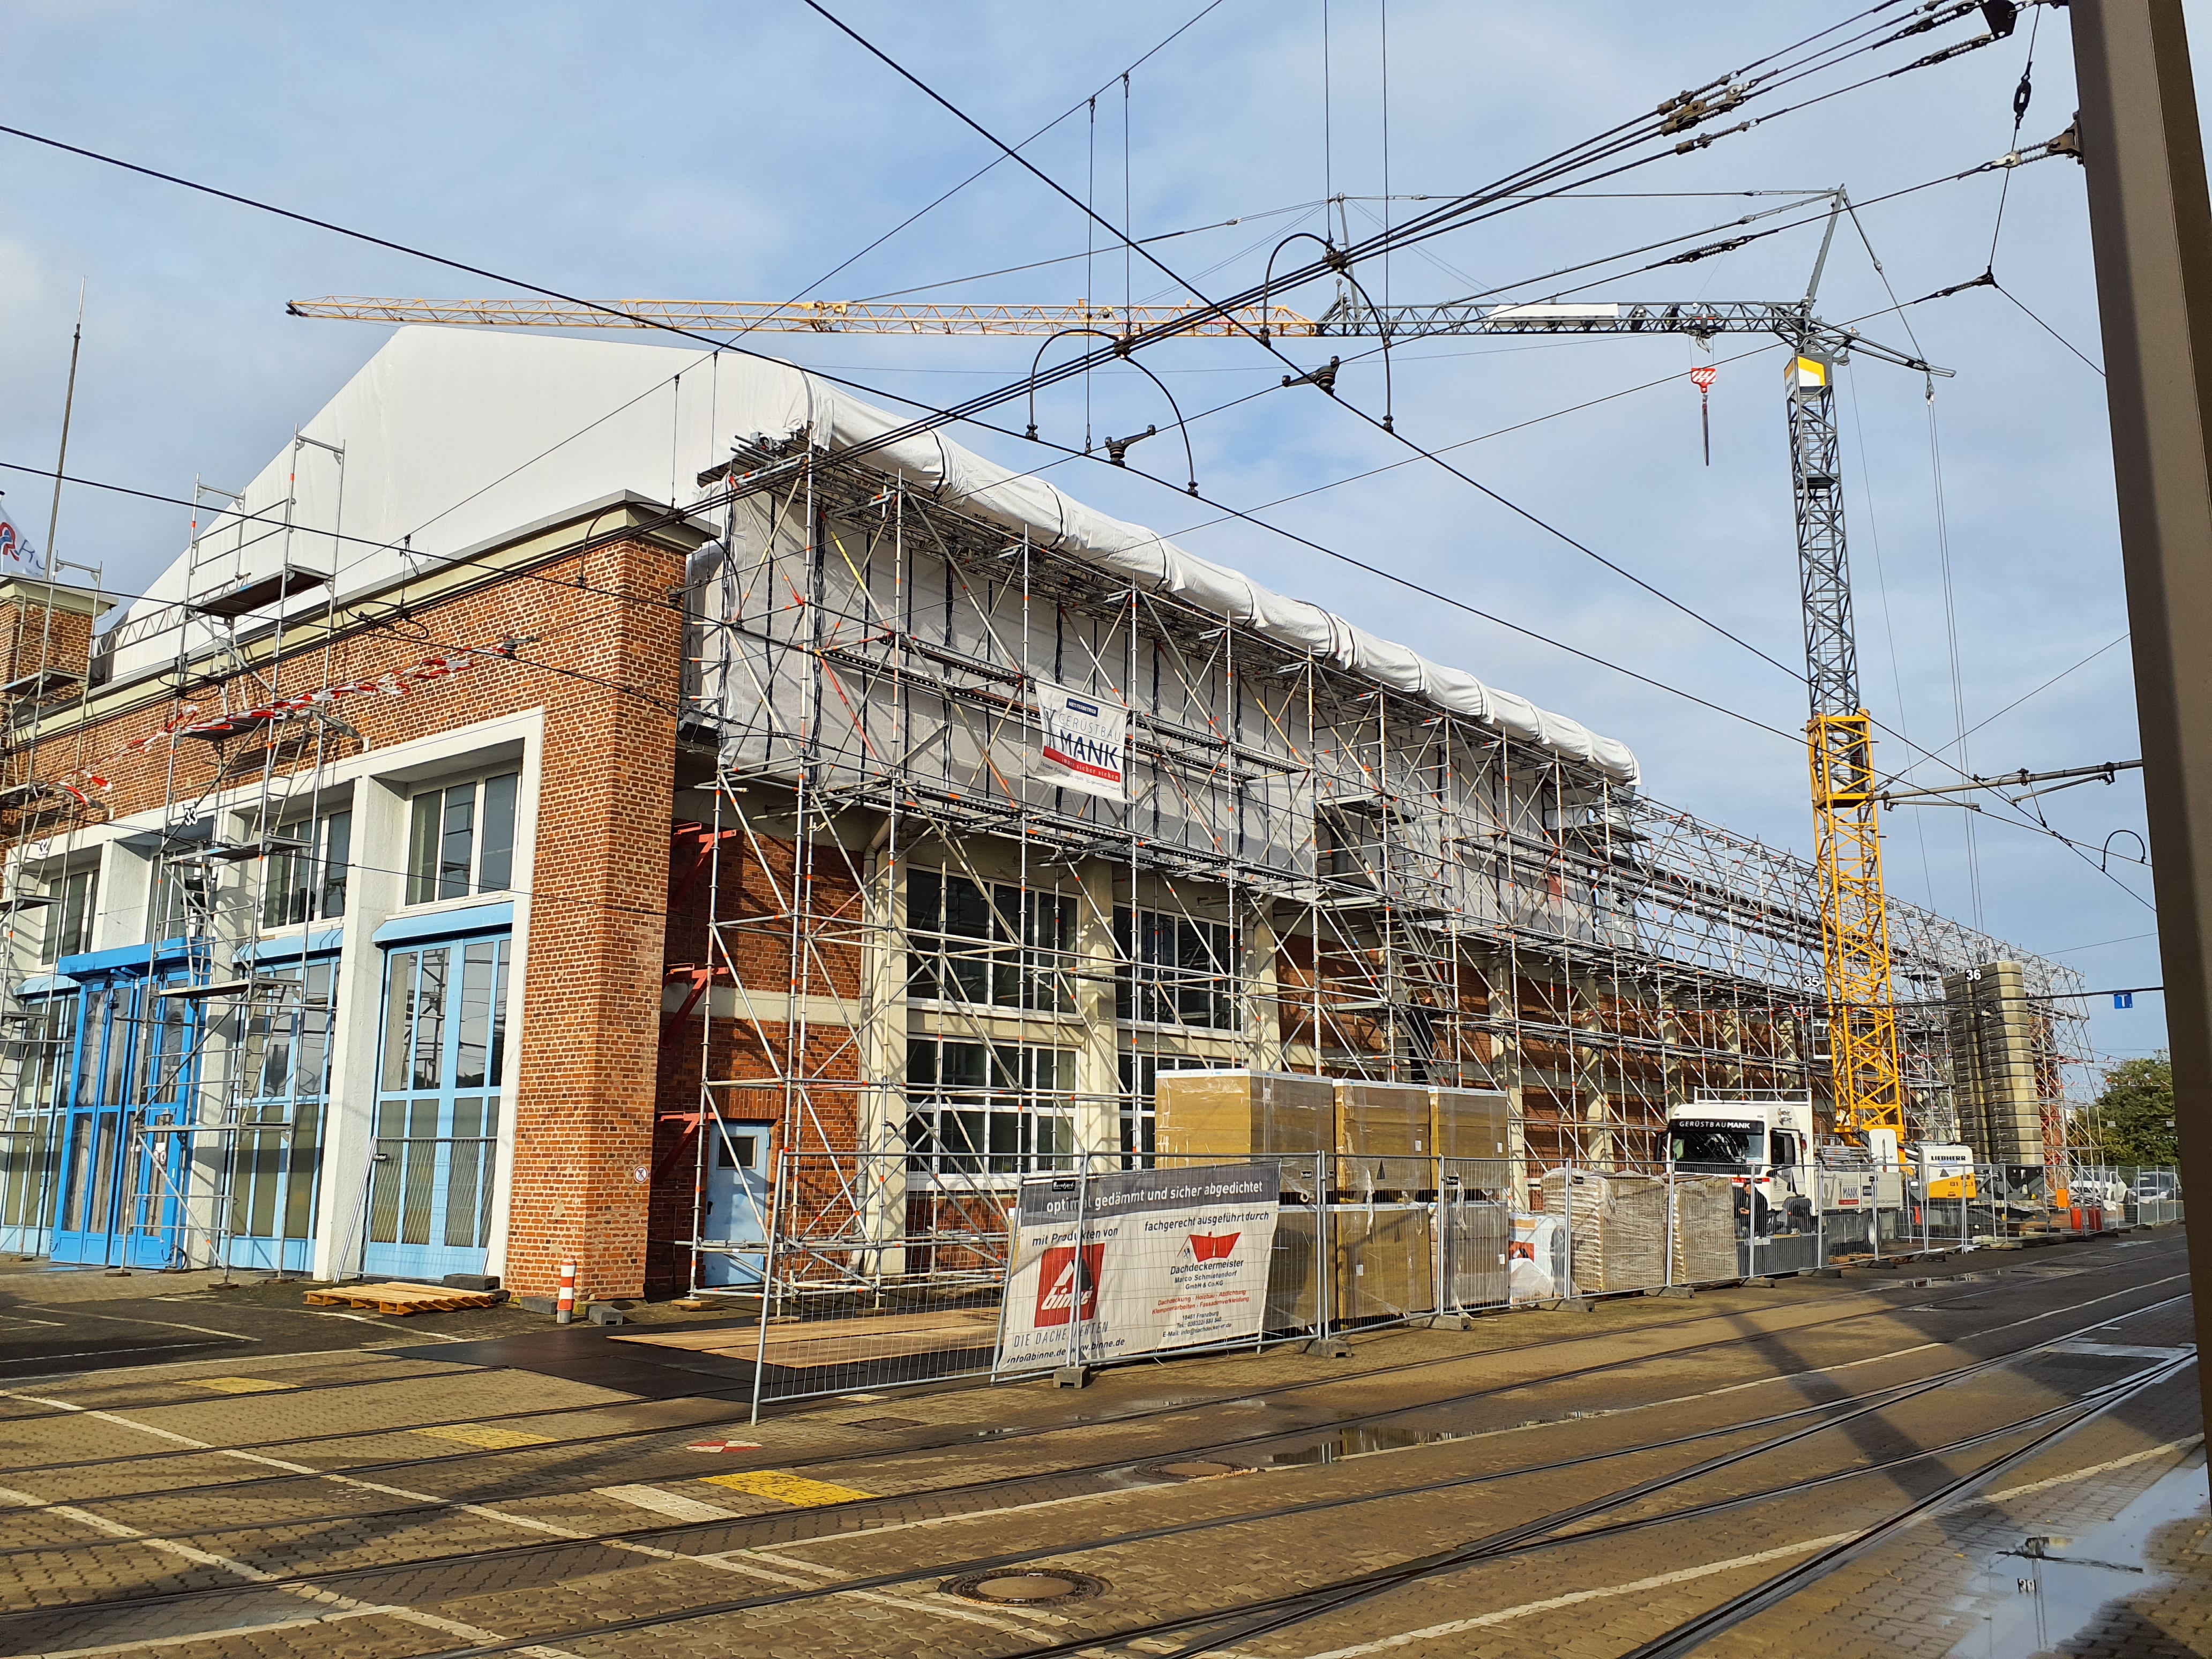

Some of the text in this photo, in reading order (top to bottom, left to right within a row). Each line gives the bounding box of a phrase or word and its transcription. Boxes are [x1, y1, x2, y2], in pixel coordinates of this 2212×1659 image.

[1058, 713, 1121, 742] GERÜSTBAU
[1059, 729, 1119, 770] MANK
[1076, 764, 1096, 774] sicher
[1098, 768, 1119, 780] stehen
[184, 807, 198, 826] 33
[39, 838, 49, 855] 32
[1635, 963, 1647, 974] 34
[1966, 969, 1982, 981] 36
[1804, 976, 1820, 987] 35
[2117, 994, 2128, 1007] T
[1047, 1180, 1263, 1215] optimal gedämmt und sicher abgedichtet
[1843, 1187, 1858, 1199] MANK
[1145, 1210, 1269, 1232] fachgerecht ausgeführt durch
[1032, 1227, 1118, 1246] mit Produkten von
[1170, 1259, 1244, 1275] Dachdeckermeister
[1175, 1275, 1192, 1284] Marco
[1158, 1296, 1191, 1306] Dachdeckung
[1014, 1320, 1109, 1348] DIE DACHEERTEN
[1007, 1348, 1066, 1364] info@binne.de
